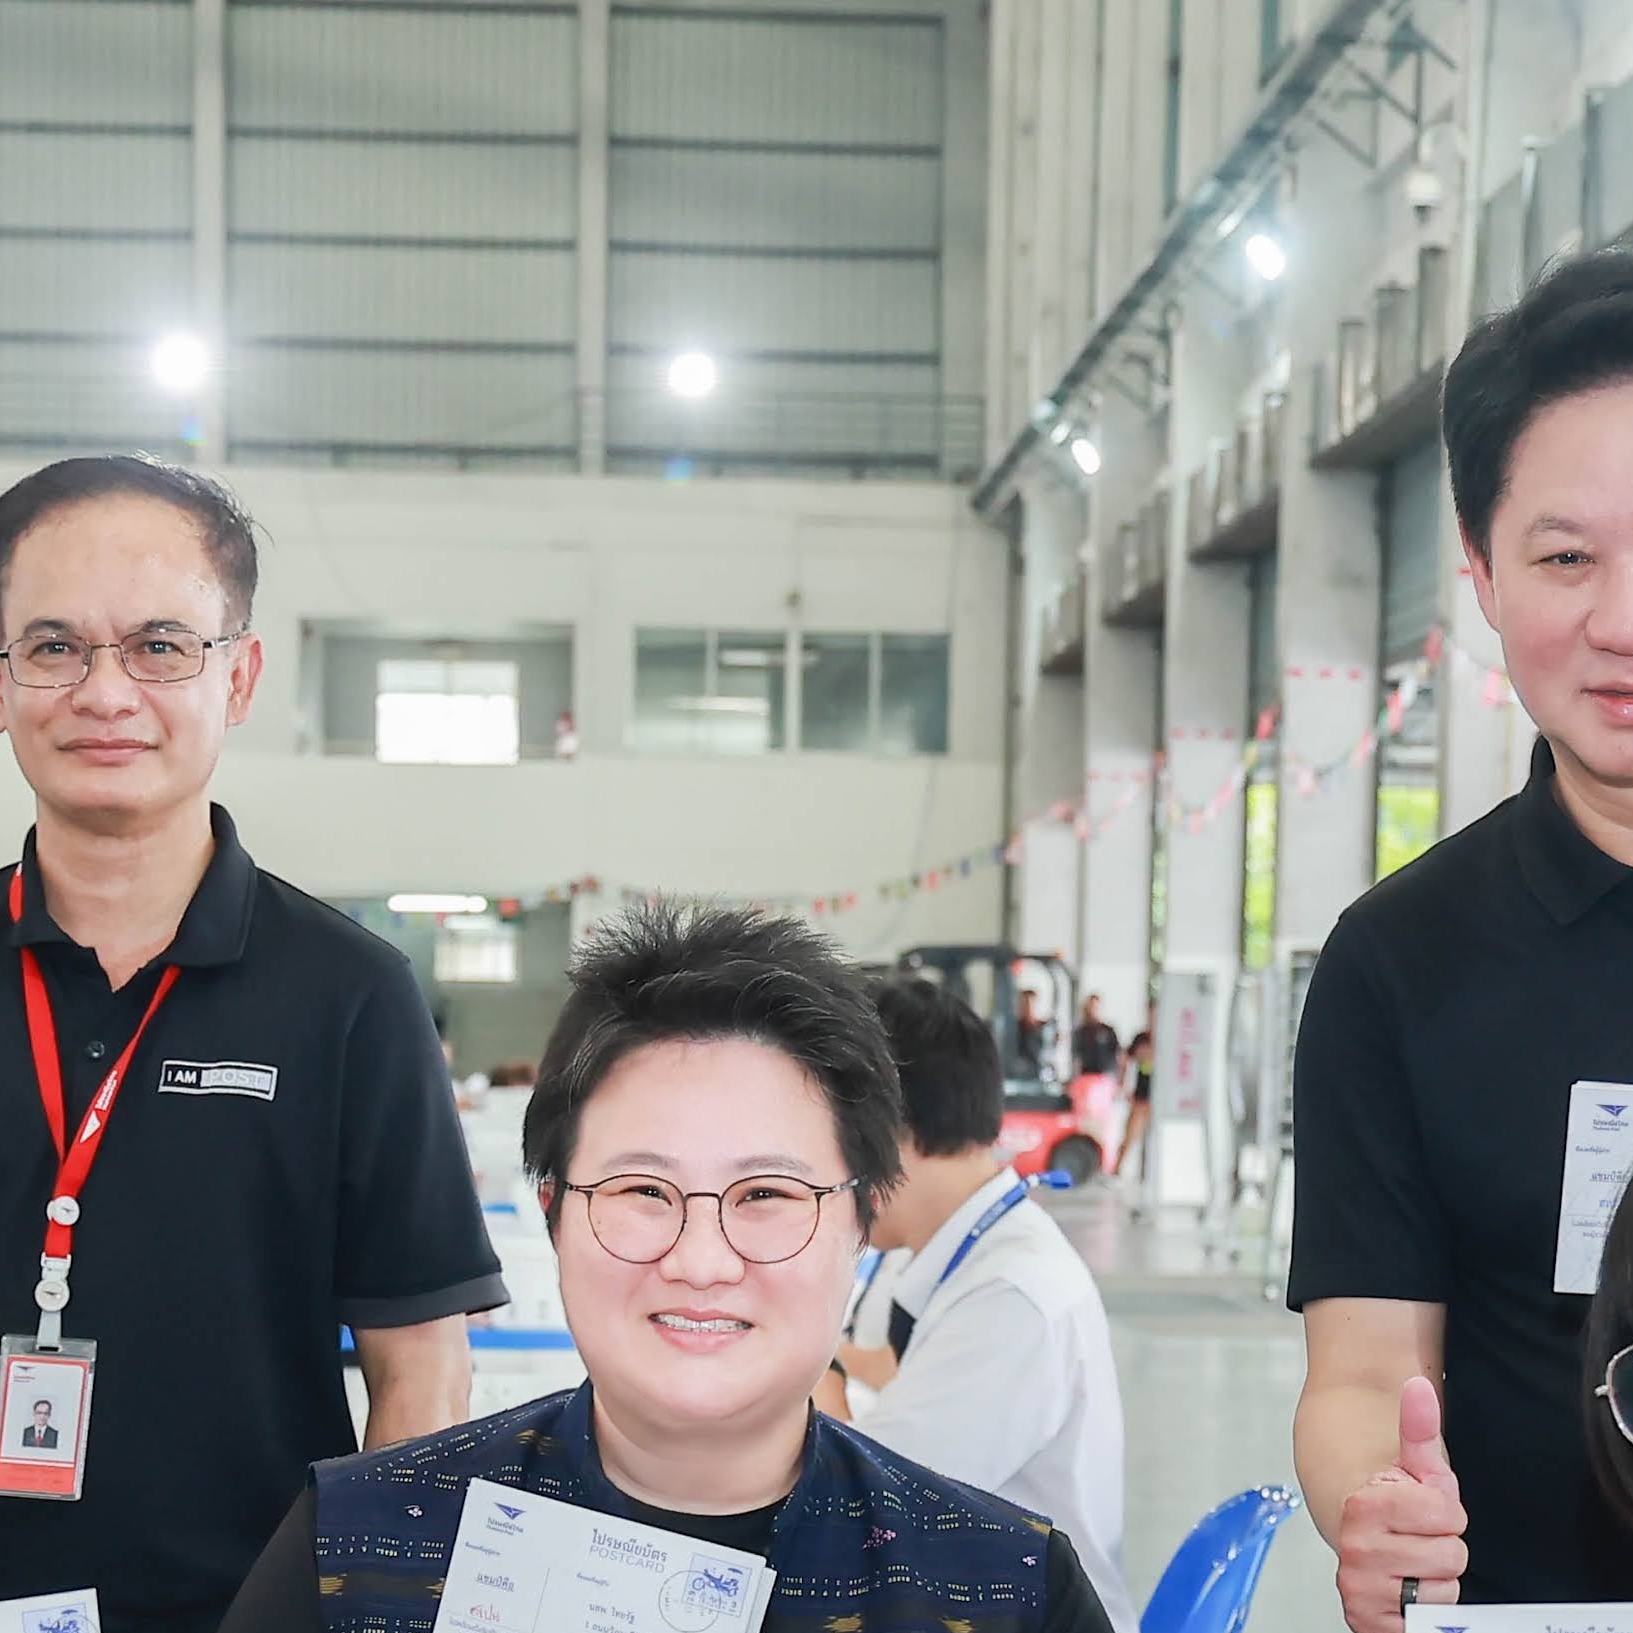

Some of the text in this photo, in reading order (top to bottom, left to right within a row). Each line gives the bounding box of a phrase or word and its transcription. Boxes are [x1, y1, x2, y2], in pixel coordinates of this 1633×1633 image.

[167, 1070, 172, 1082] I
[174, 1070, 197, 1084] AM
[589, 1544, 666, 1574] POSTCARD
[592, 1528, 668, 1562] ไปรษณียบัตร
